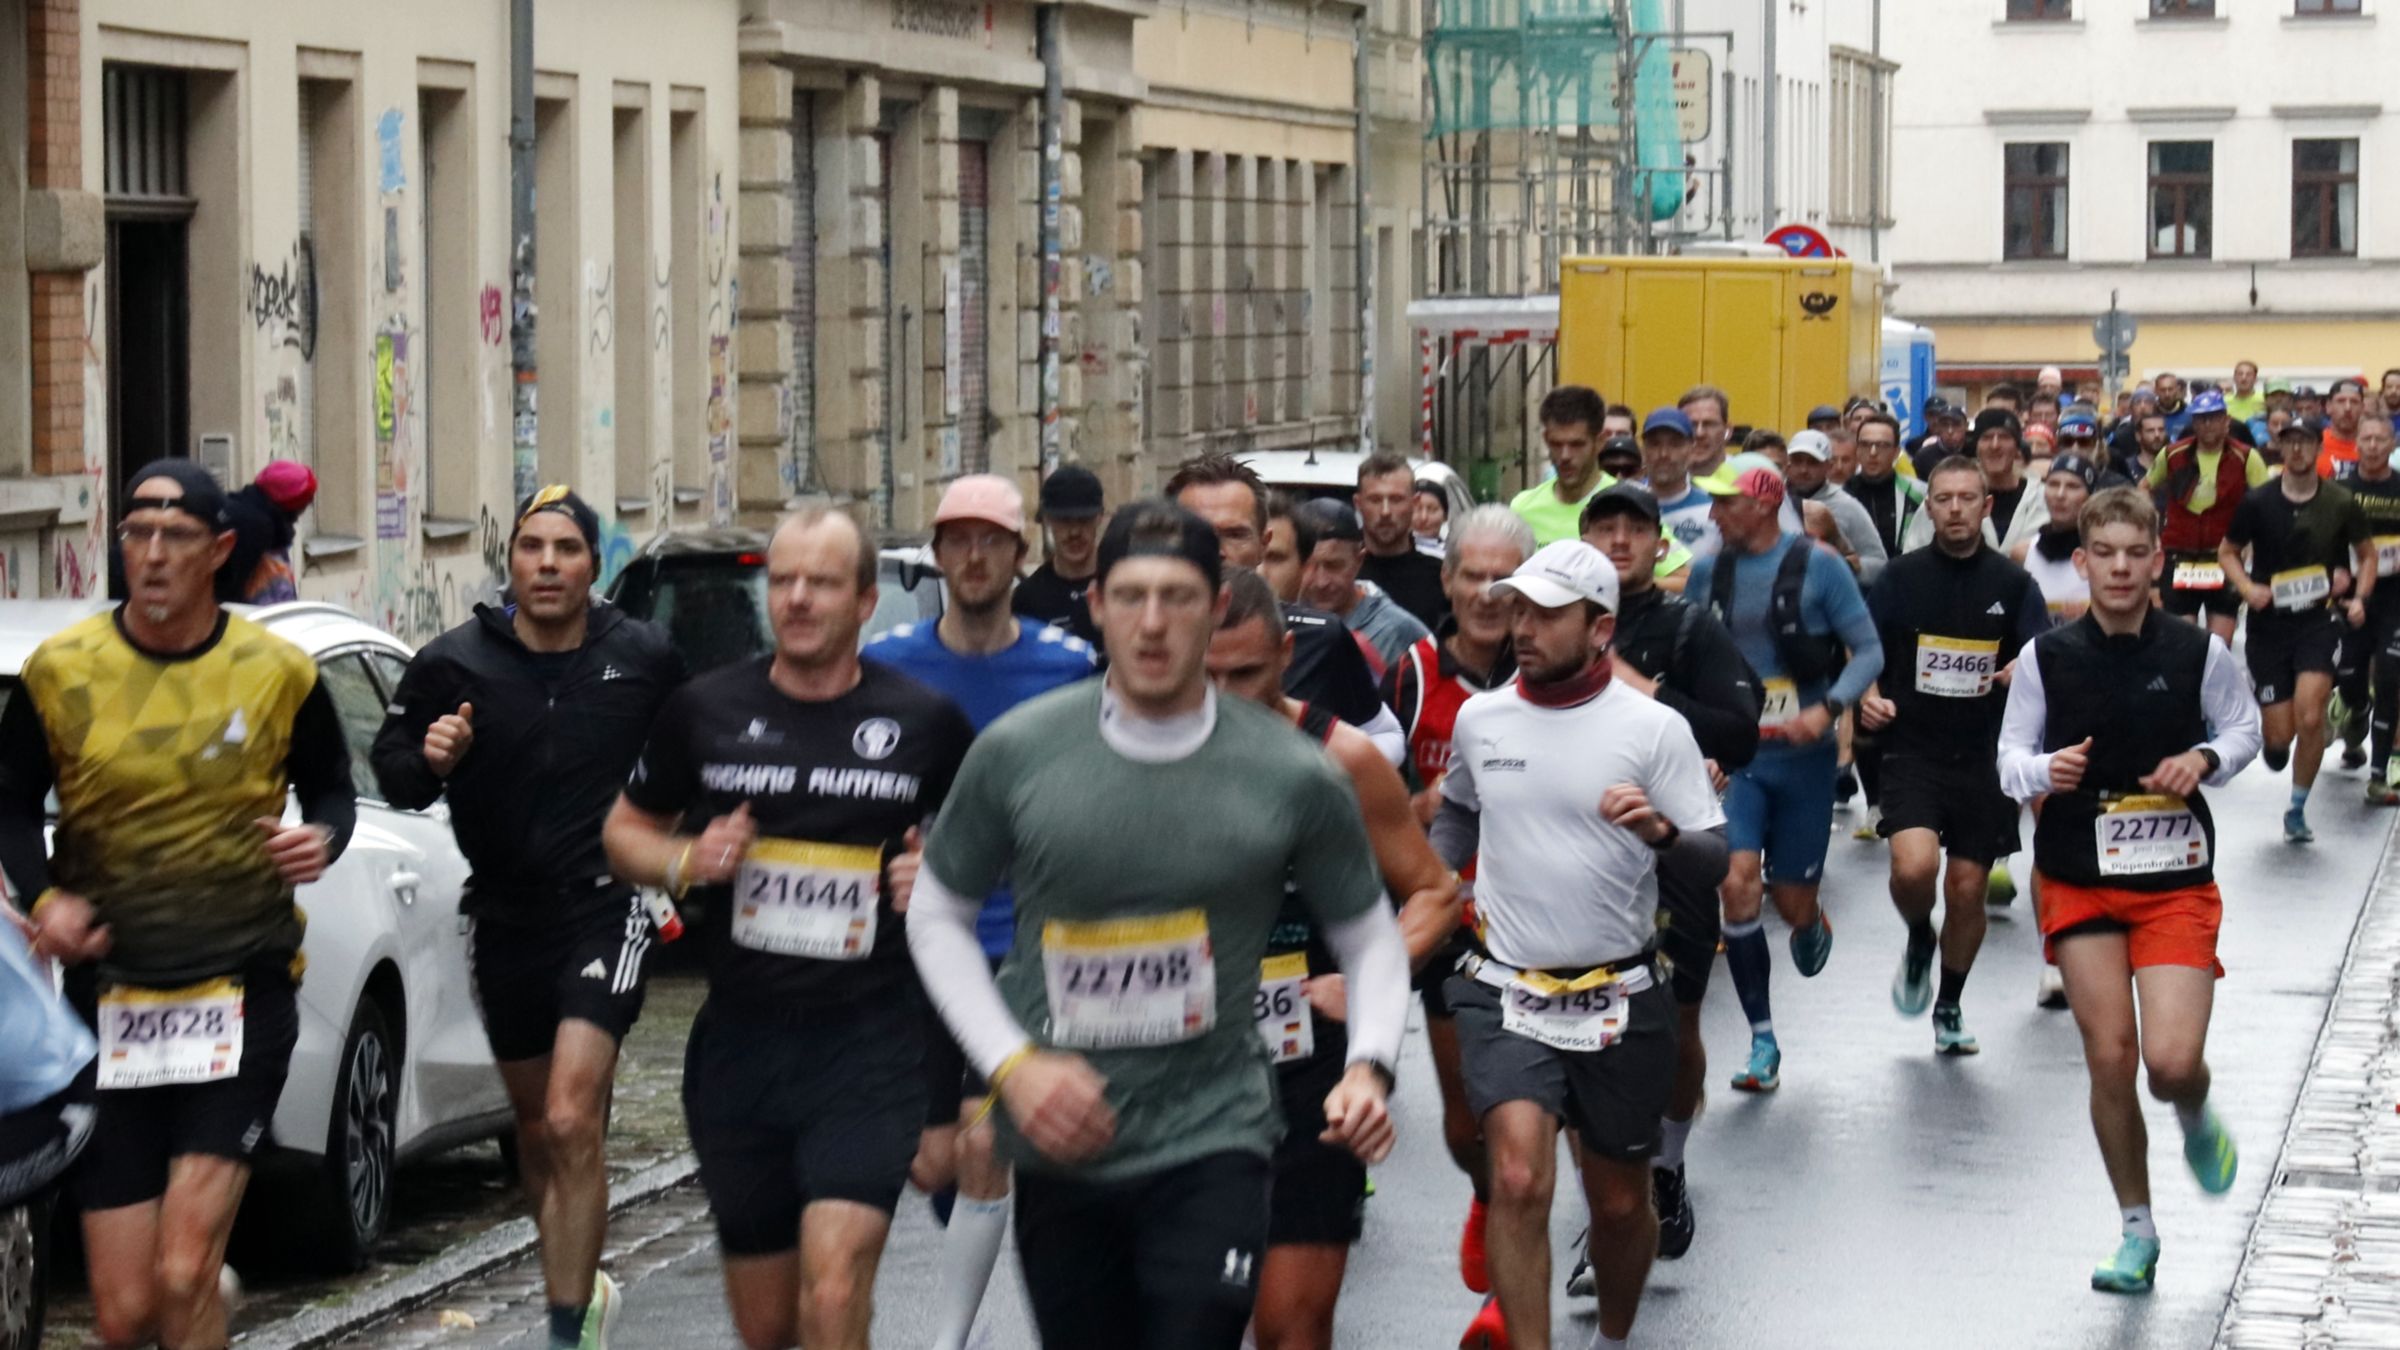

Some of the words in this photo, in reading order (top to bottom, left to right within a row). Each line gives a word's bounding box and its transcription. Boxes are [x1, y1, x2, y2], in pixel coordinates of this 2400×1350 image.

[1926, 652, 1988, 674] 23466
[2111, 814, 2193, 842] 22777
[751, 867, 861, 911] 21644
[1064, 947, 1192, 997] 22798
[119, 1006, 225, 1046] 25628
